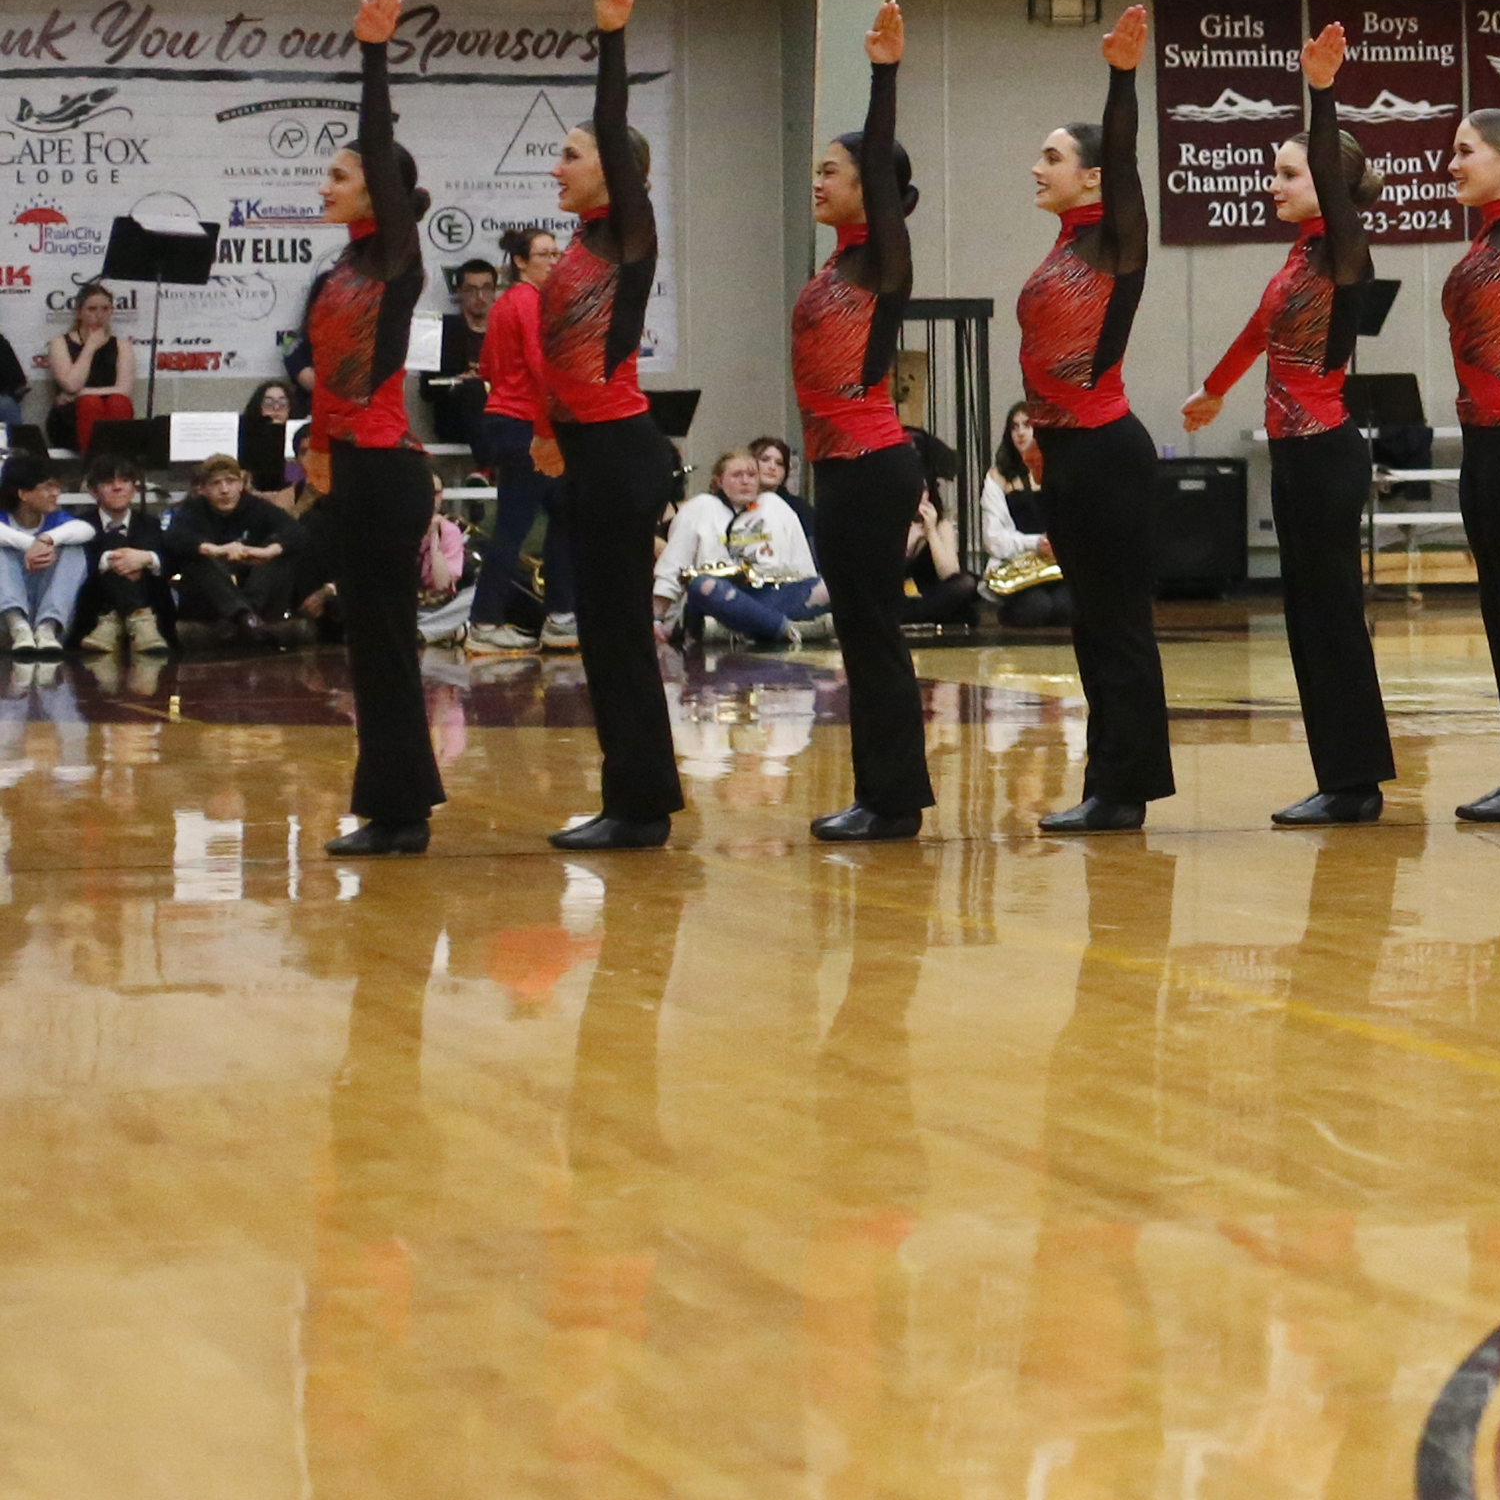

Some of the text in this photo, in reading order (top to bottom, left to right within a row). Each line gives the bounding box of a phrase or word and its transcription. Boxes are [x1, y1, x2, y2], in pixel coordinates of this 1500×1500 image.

[91, 0, 211, 64] You
[215, 12, 267, 62] to
[1200, 14, 1264, 38] Girls
[1363, 12, 1418, 40] Boys
[17, 169, 119, 184] LODGE
[1208, 202, 1266, 227] 2012
[252, 239, 312, 263] ELLIS
